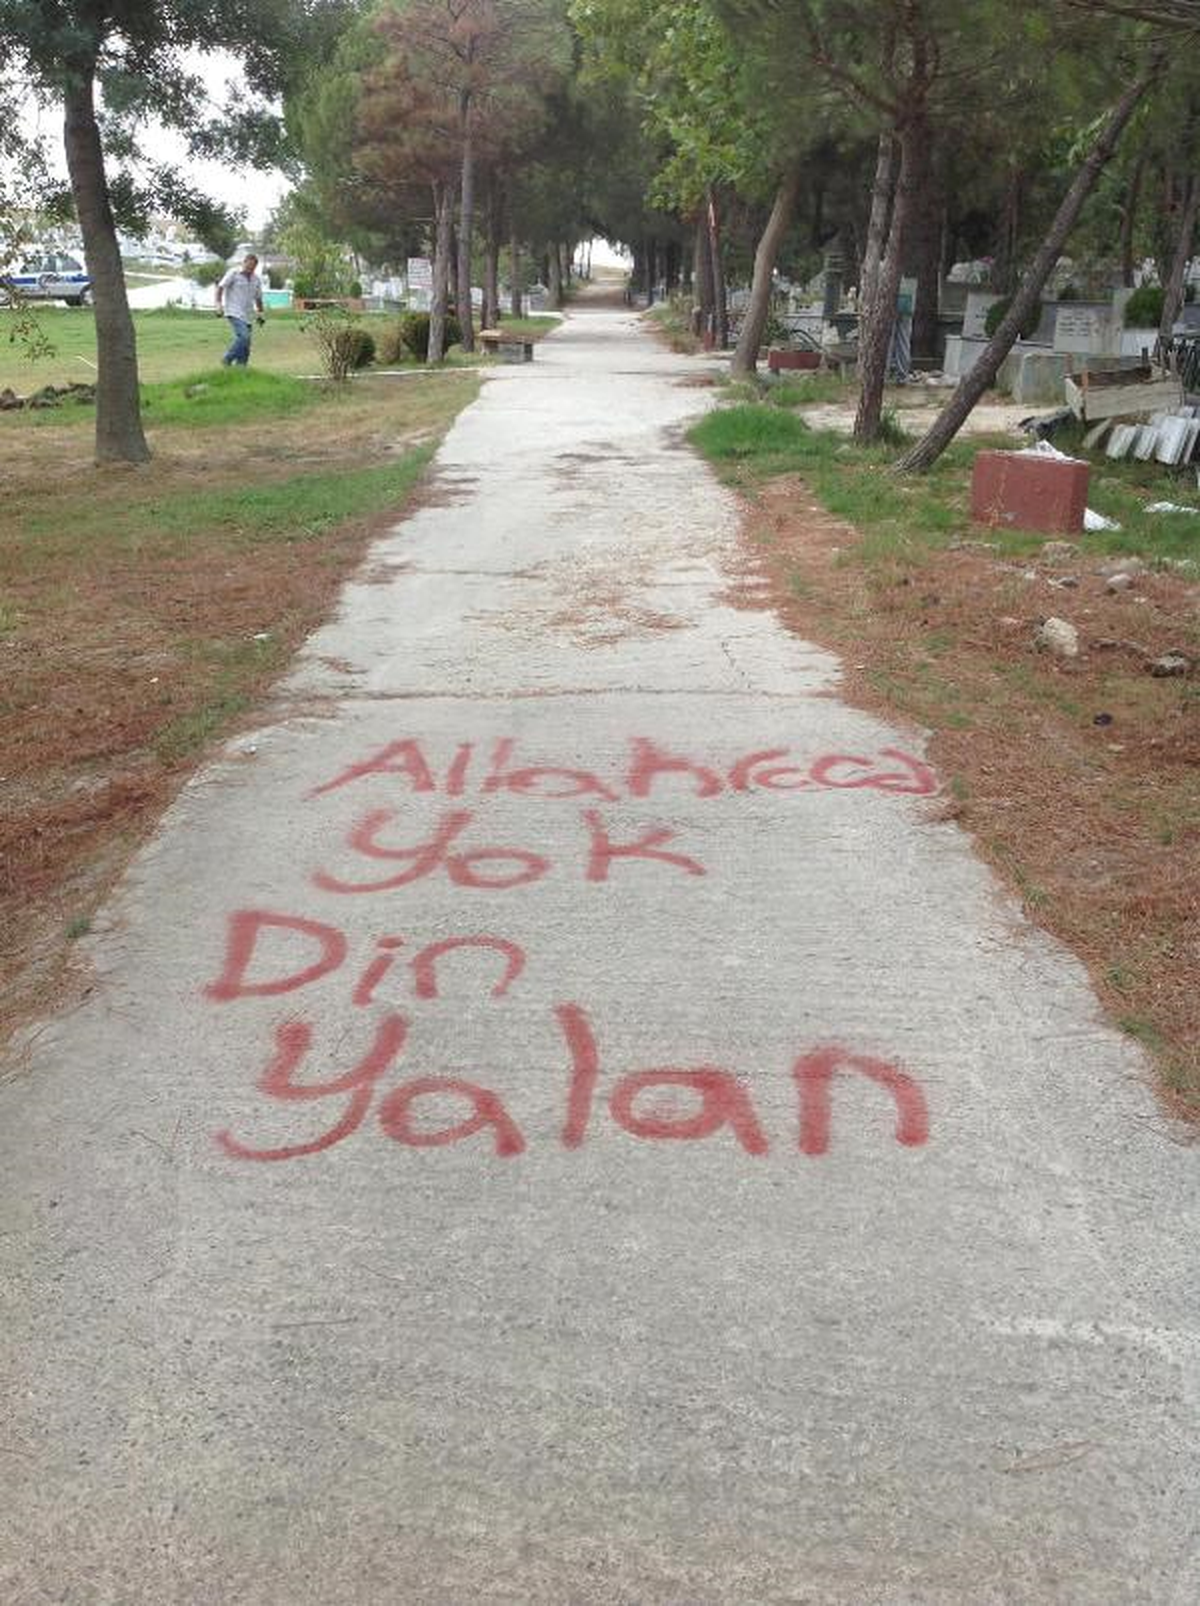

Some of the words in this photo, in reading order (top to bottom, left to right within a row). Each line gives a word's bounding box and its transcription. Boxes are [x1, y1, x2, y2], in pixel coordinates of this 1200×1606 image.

[306, 737, 722, 801] Allah
[202, 909, 527, 1006] Din
[214, 1001, 931, 1161] Yalan
